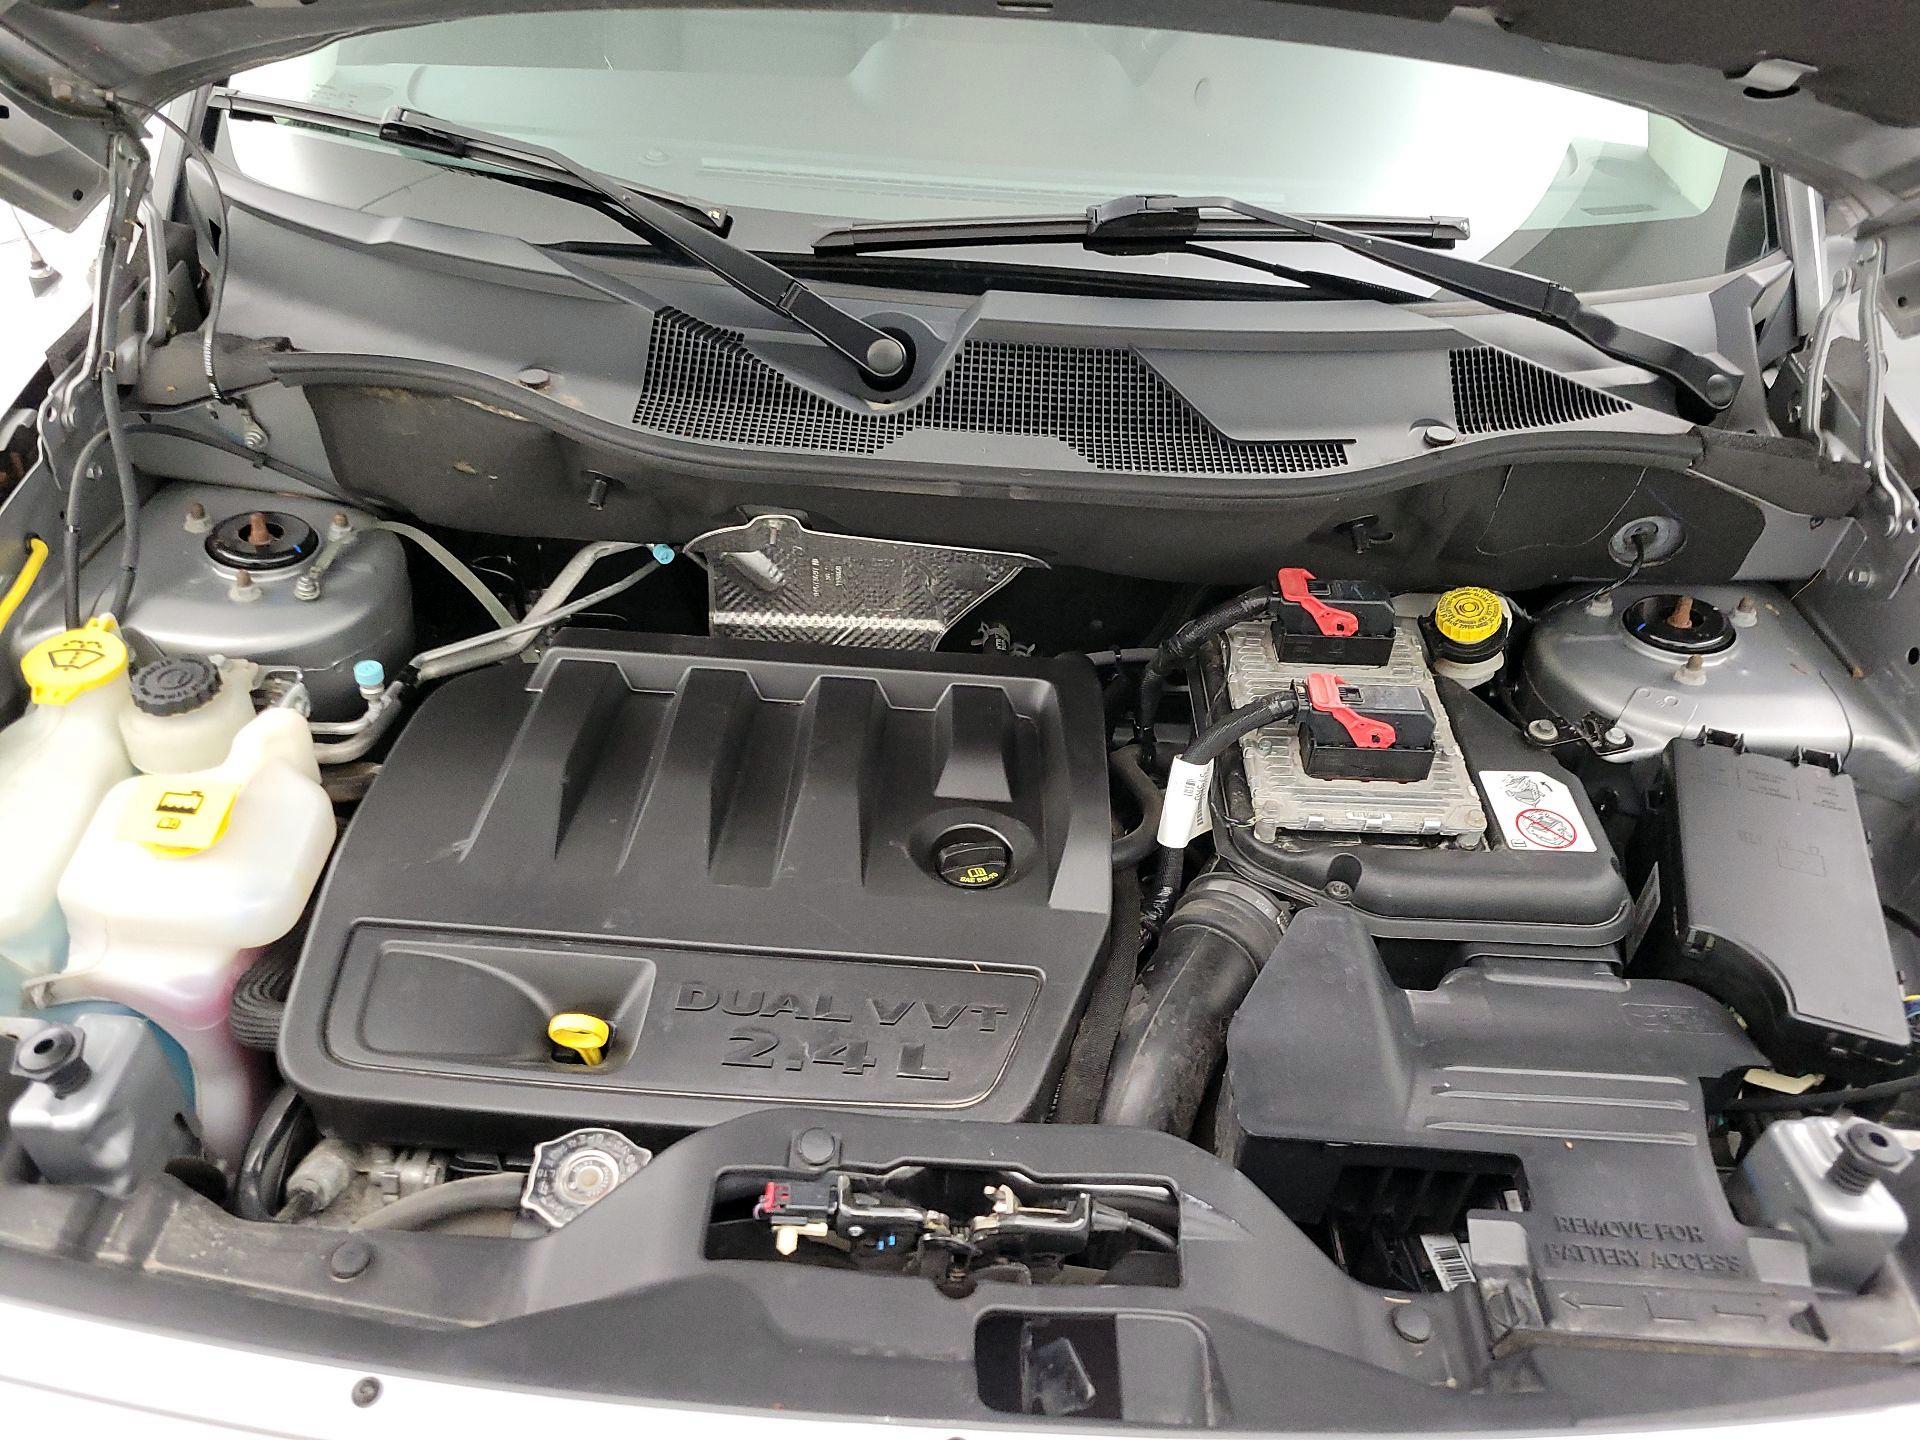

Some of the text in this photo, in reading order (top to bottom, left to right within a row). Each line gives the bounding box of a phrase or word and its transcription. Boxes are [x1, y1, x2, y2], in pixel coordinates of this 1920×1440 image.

[674, 982, 1008, 1032] DUAL VVT
[721, 1028, 951, 1082] 2.4 L
[1553, 1215, 1706, 1243] REMOVE FOR
[1543, 1241, 1741, 1273] BATTERY ACCESS
